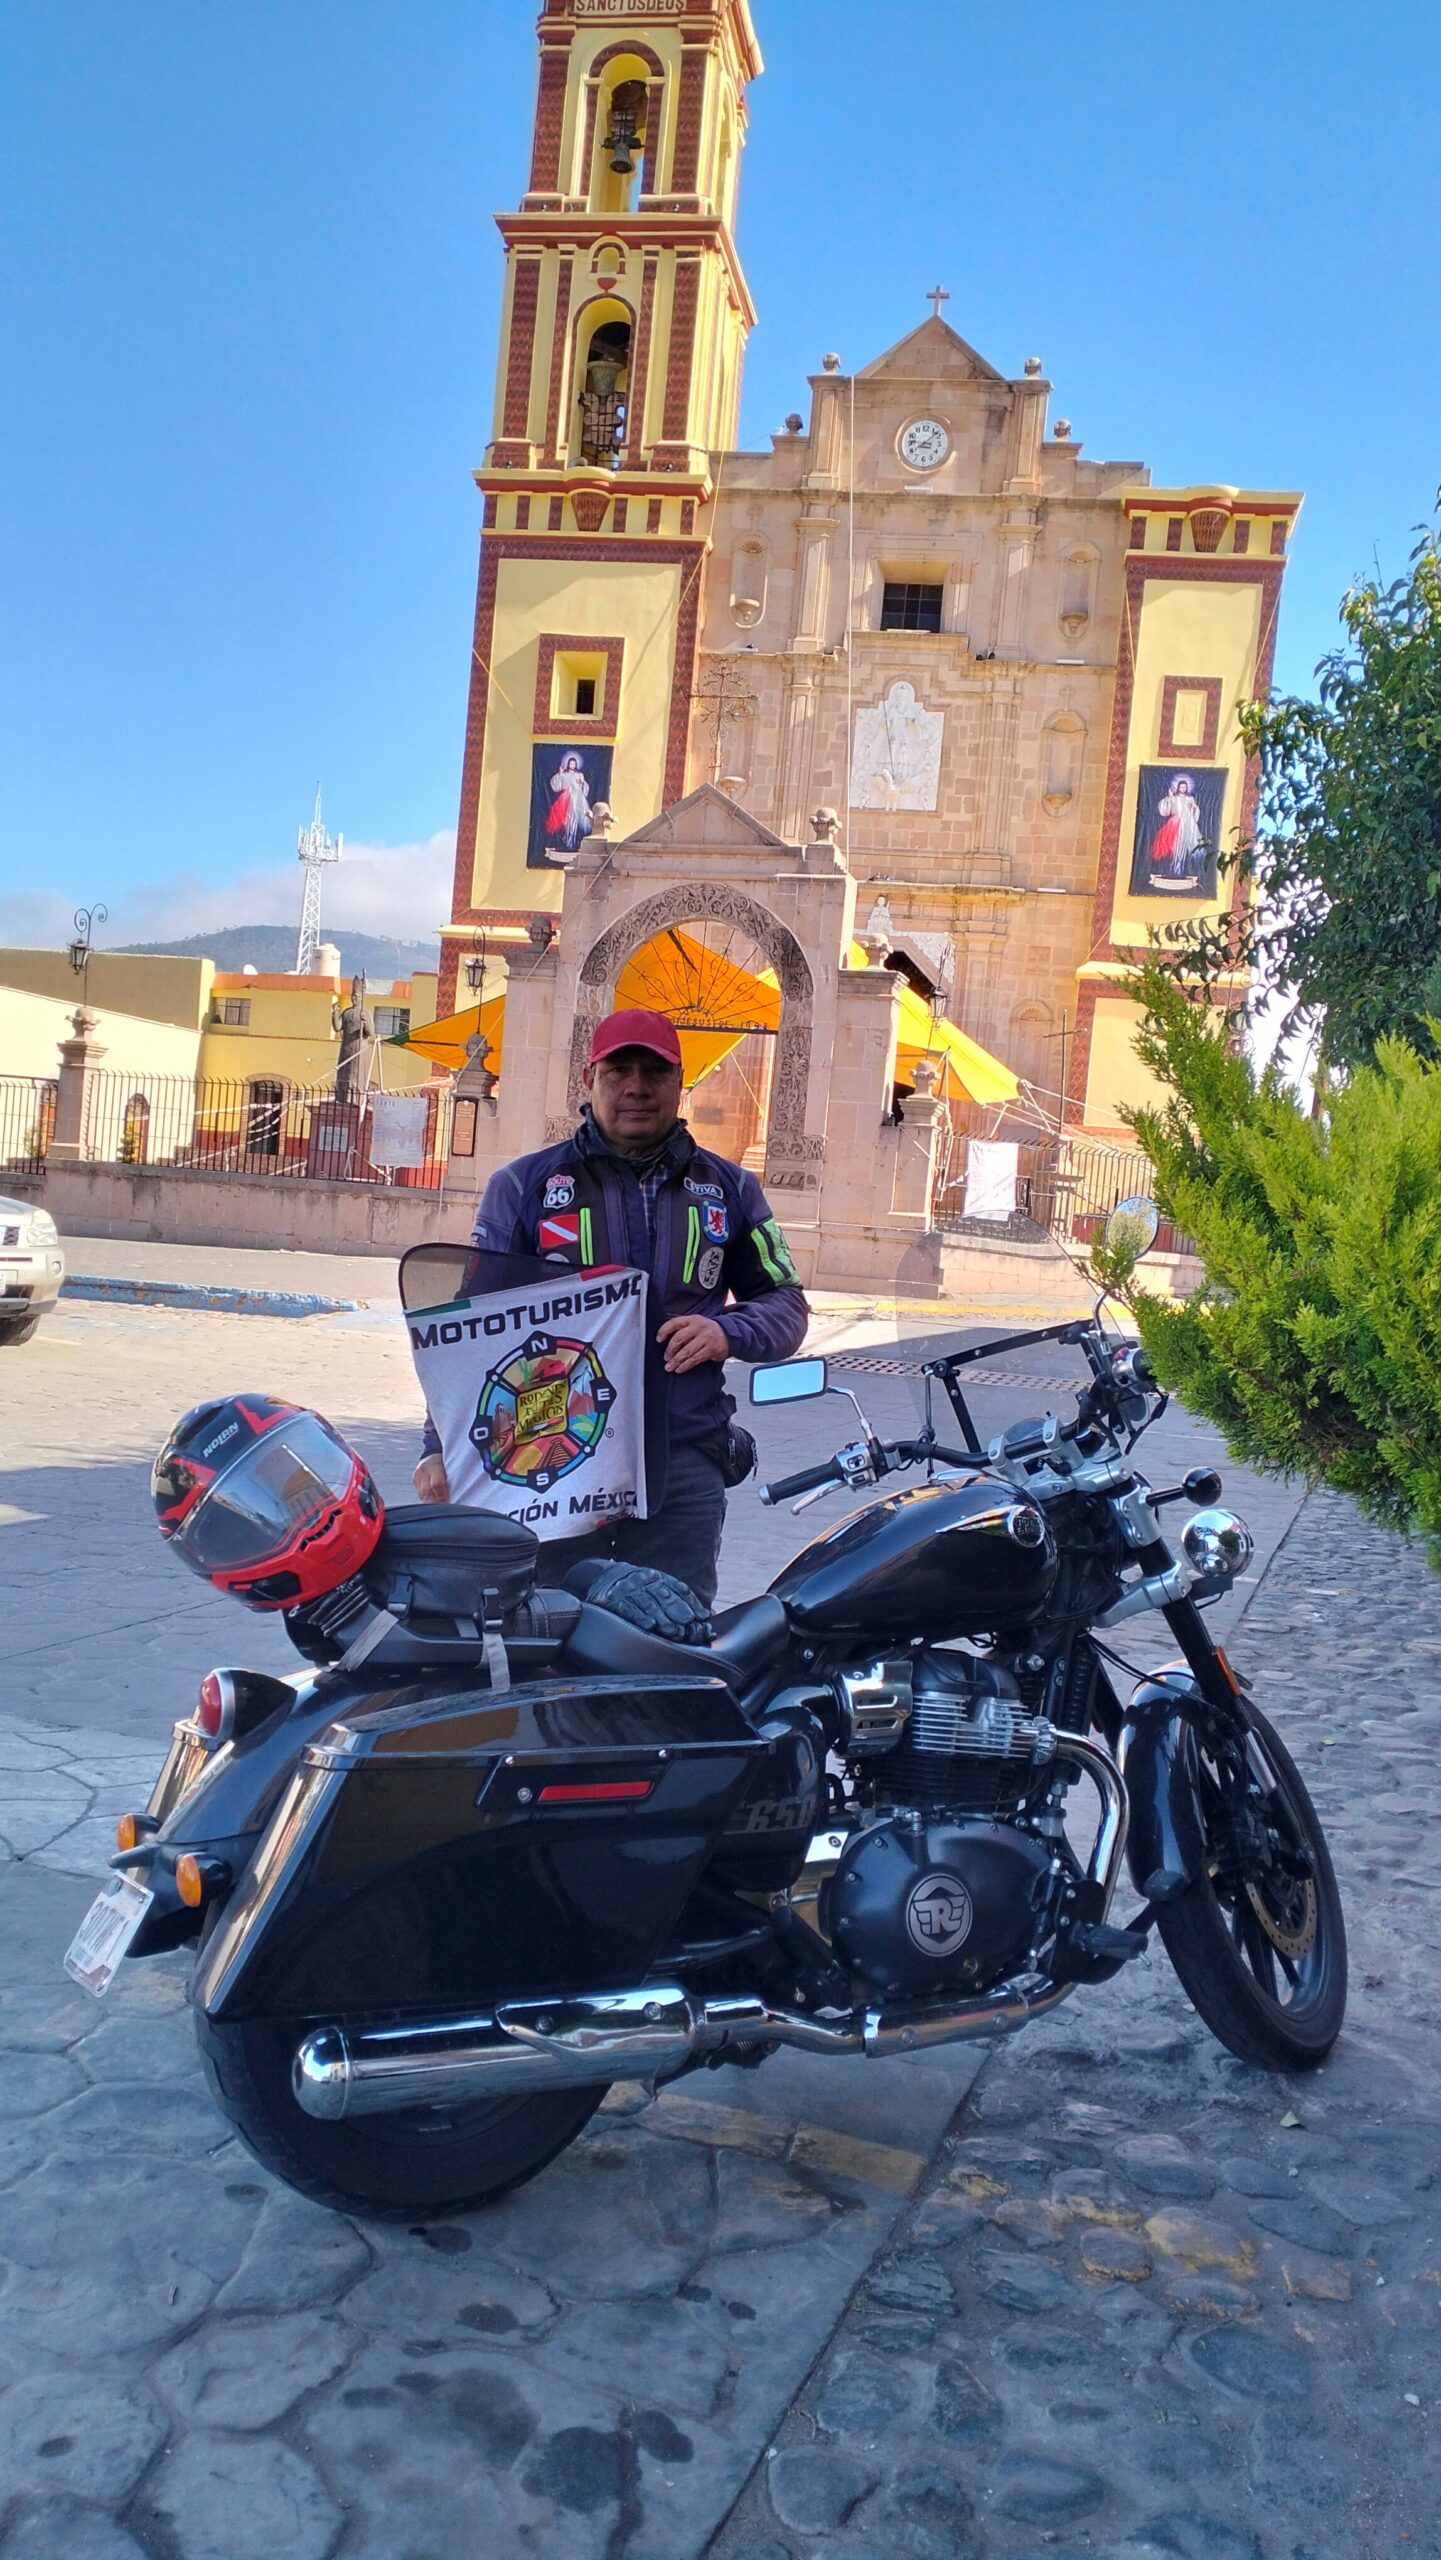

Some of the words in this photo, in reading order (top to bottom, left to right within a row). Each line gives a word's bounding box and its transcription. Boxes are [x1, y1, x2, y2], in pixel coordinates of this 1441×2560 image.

[547, 1188, 570, 1205] 66
[531, 1338, 548, 1352] N
[597, 1388, 610, 1401] E
[203, 1422, 239, 1458] NOLAN
[474, 1427, 488, 1440] O
[536, 1473, 549, 1486] S
[569, 1488, 637, 1514] MÉXIC
